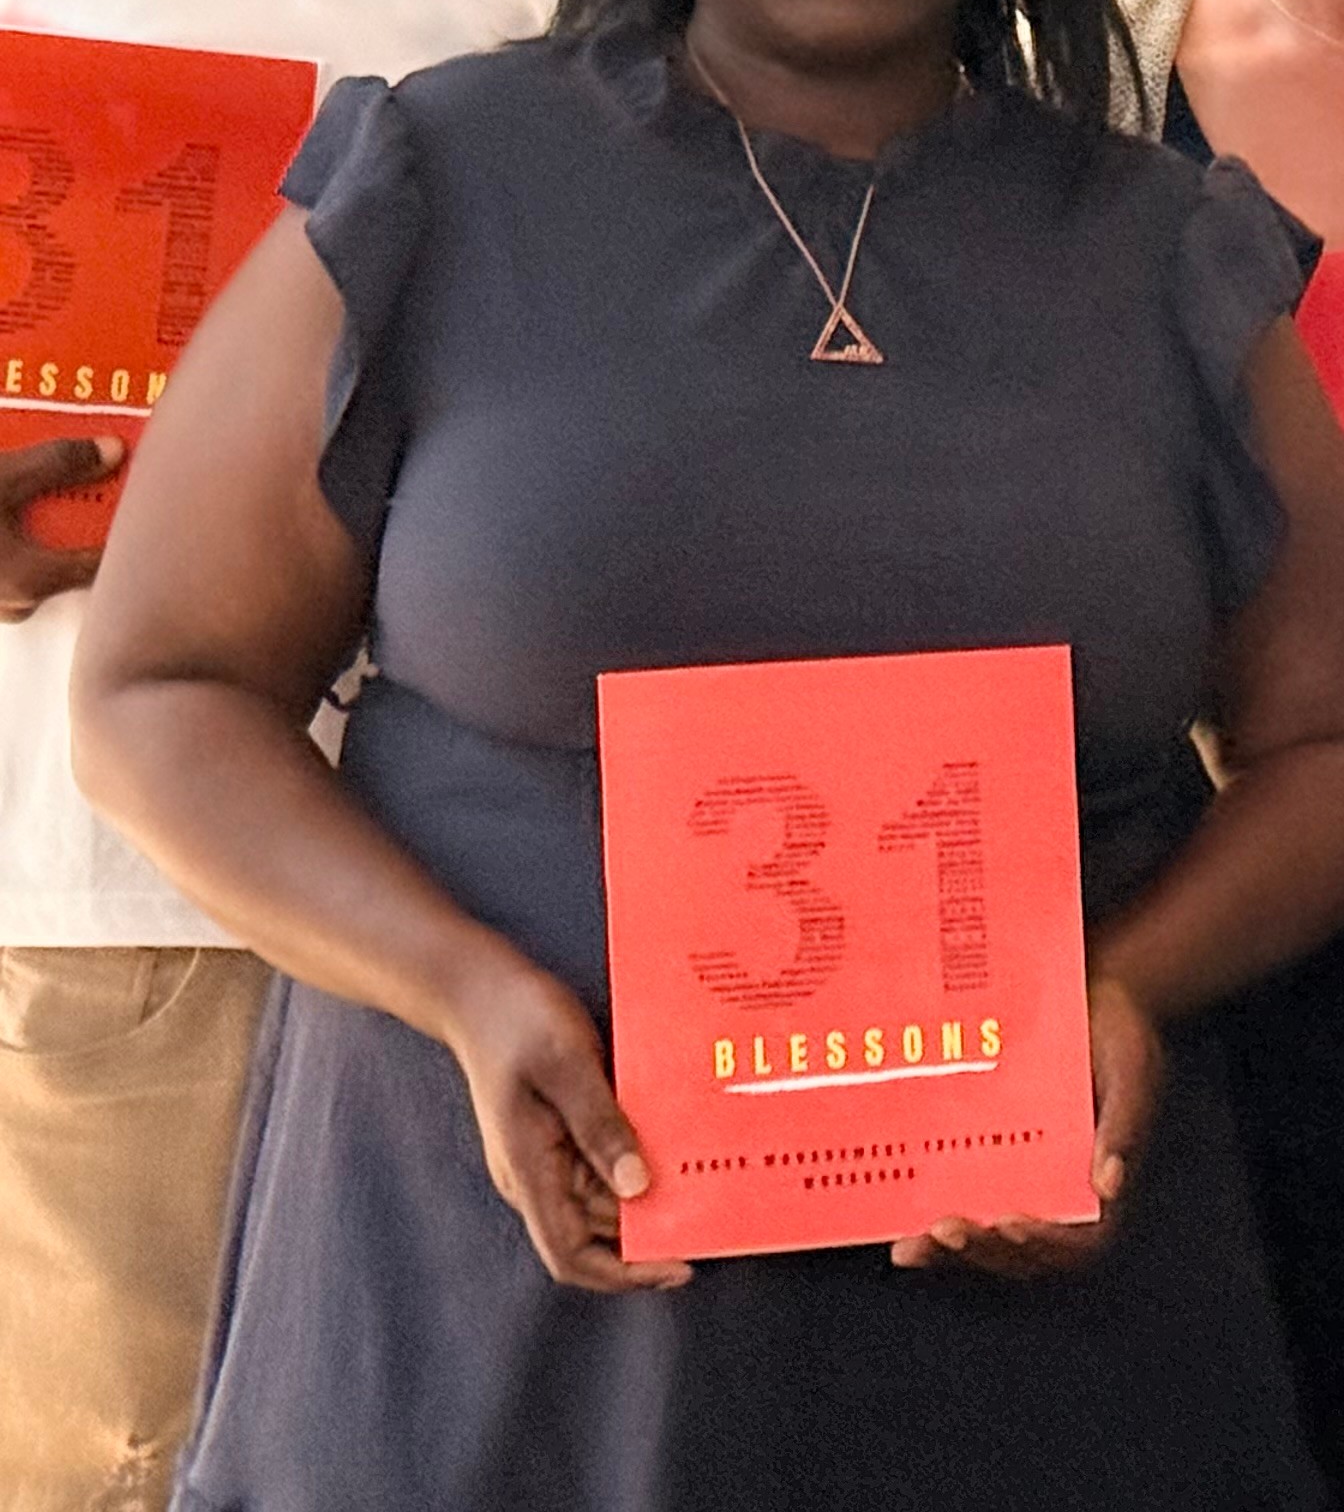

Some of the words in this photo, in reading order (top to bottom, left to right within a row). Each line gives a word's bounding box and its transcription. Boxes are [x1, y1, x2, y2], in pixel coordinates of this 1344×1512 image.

[4, 359, 168, 405] ESSON
[686, 760, 990, 1011] 31
[713, 1018, 1002, 1079] BLESSONS
